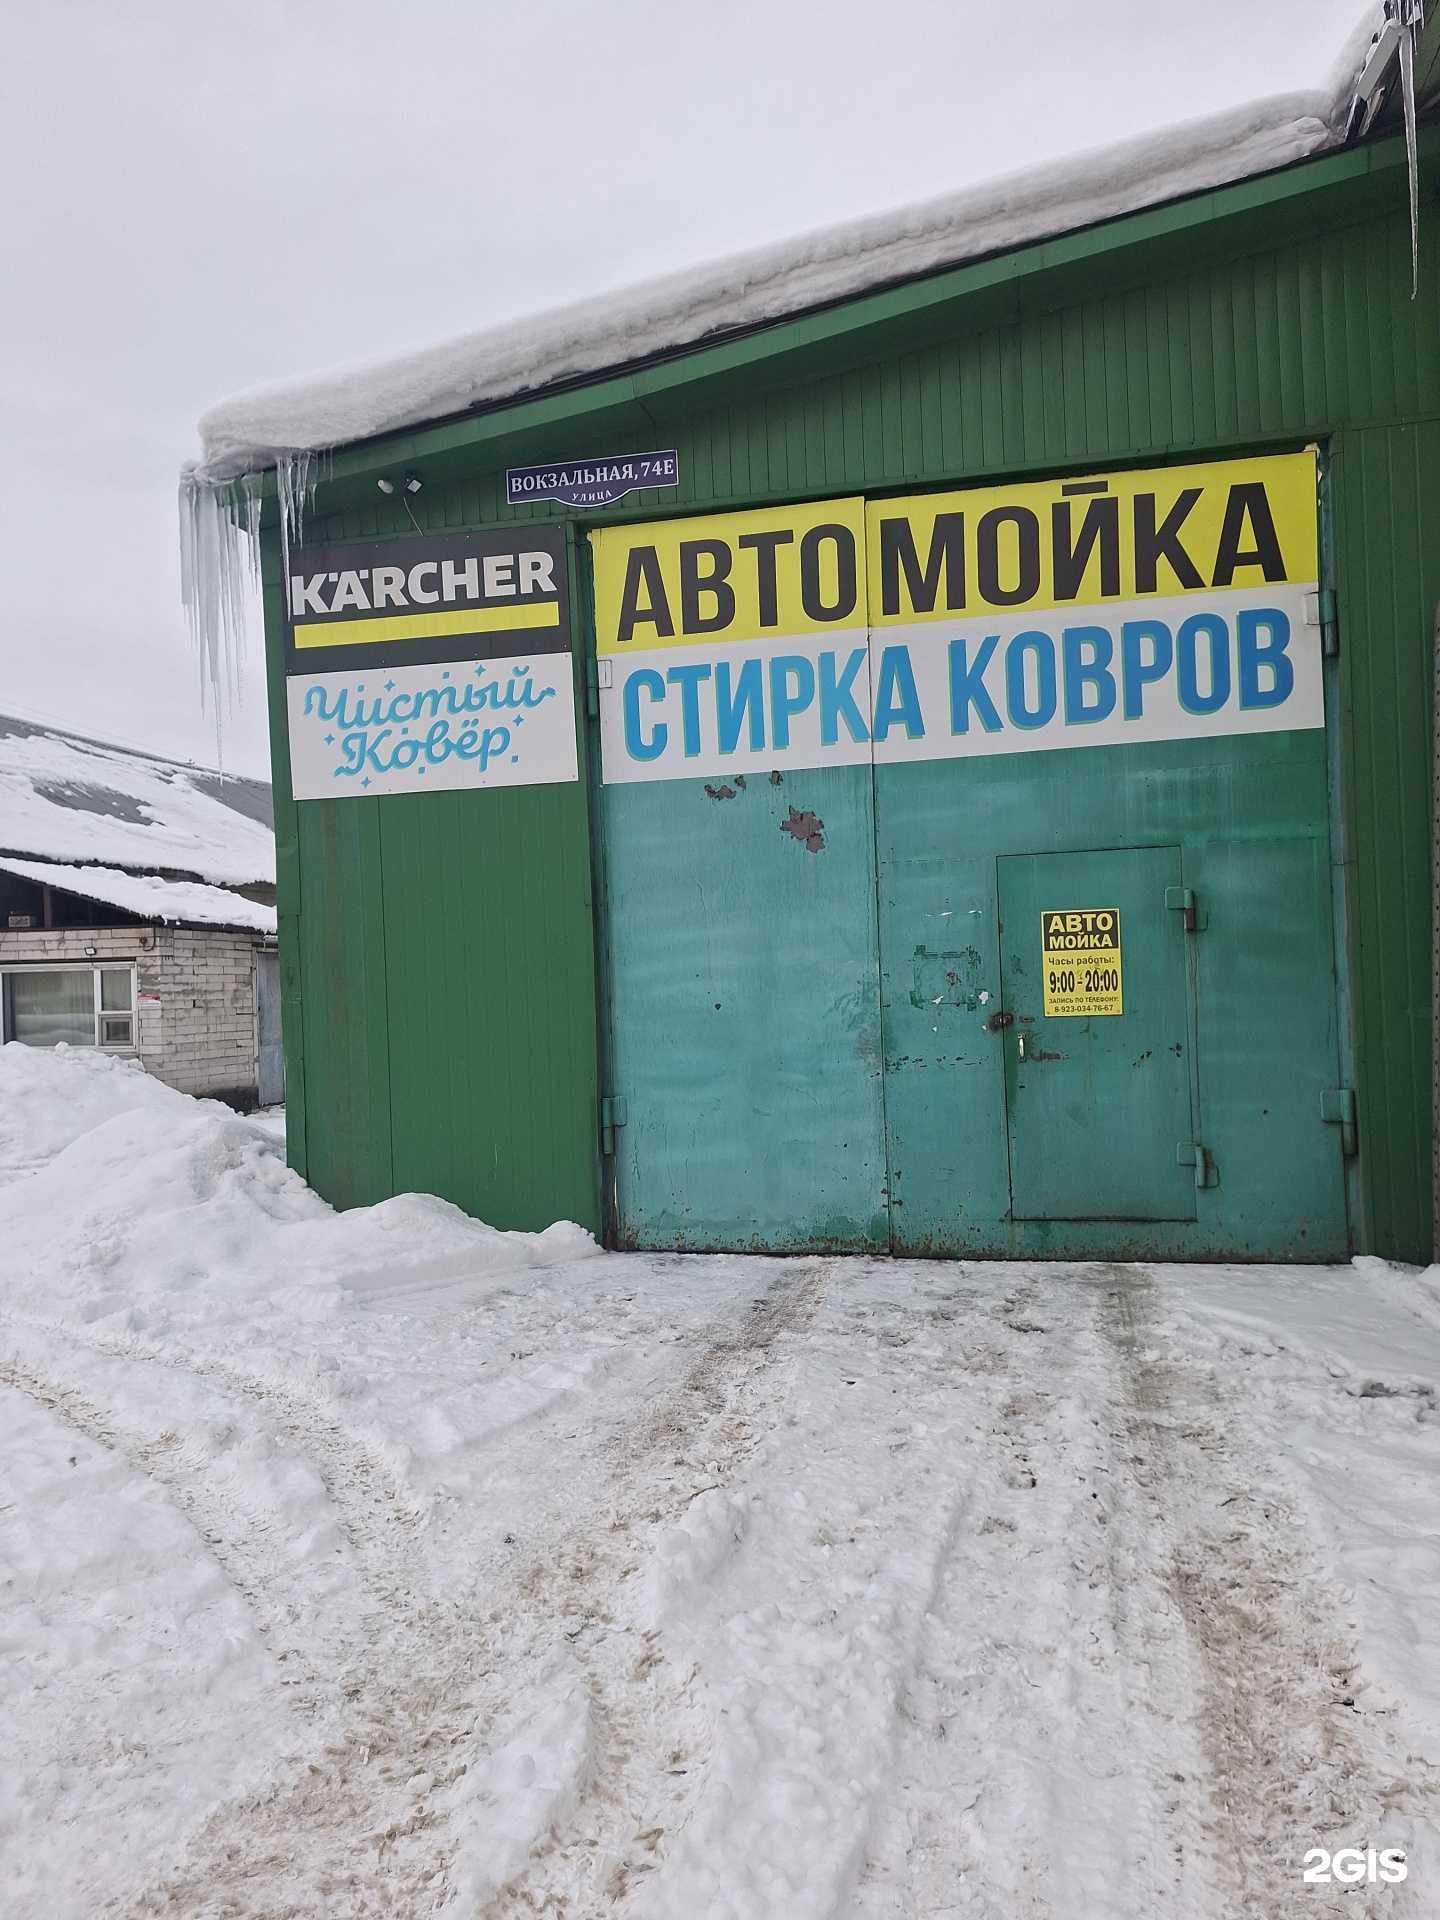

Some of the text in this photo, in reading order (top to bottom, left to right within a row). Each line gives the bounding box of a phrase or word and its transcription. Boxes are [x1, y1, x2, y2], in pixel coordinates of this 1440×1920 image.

[640, 459, 674, 477] 74Е
[572, 490, 613, 502] УЛИЦА
[290, 551, 558, 616] KÄRCHER
[622, 607, 1295, 762] СТИРКА КОВРОВ
[303, 664, 556, 730] Чистый
[1049, 912, 1114, 933] АВТО
[1049, 931, 1113, 950] МОЙКА
[1048, 956, 1115, 967] Часы работы:
[1049, 971, 1075, 993] 9:00
[1085, 969, 1118, 992] 20:00
